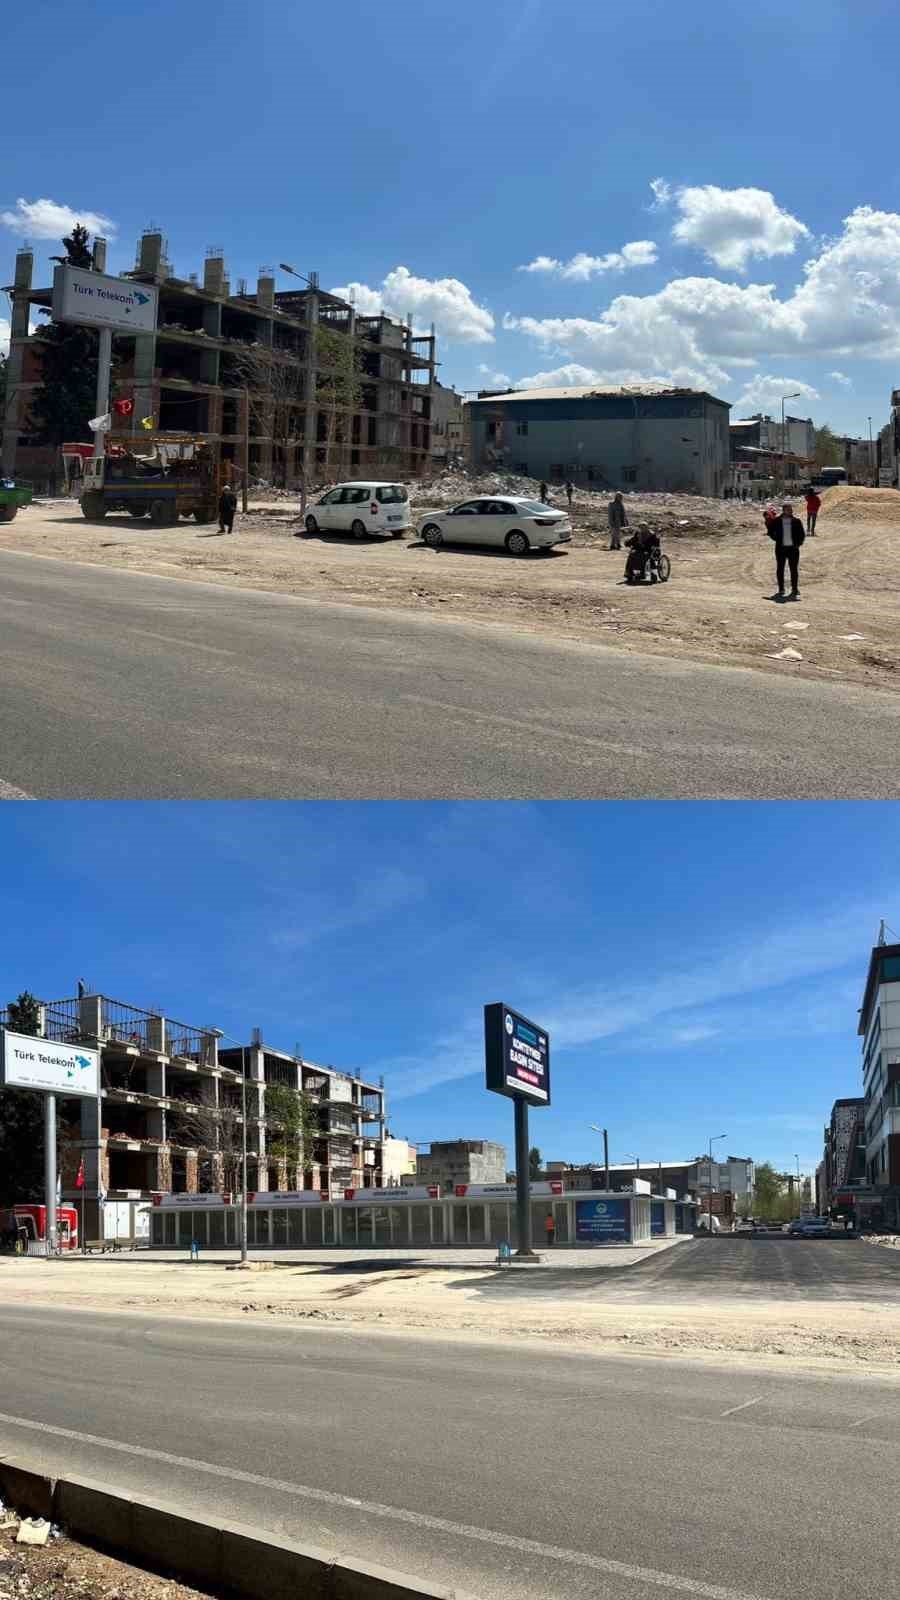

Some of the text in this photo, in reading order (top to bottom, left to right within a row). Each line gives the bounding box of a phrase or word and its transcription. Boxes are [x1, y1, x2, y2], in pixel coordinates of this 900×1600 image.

[97, 288, 134, 304] Telekom
[14, 1049, 75, 1068] Türk Telekom
